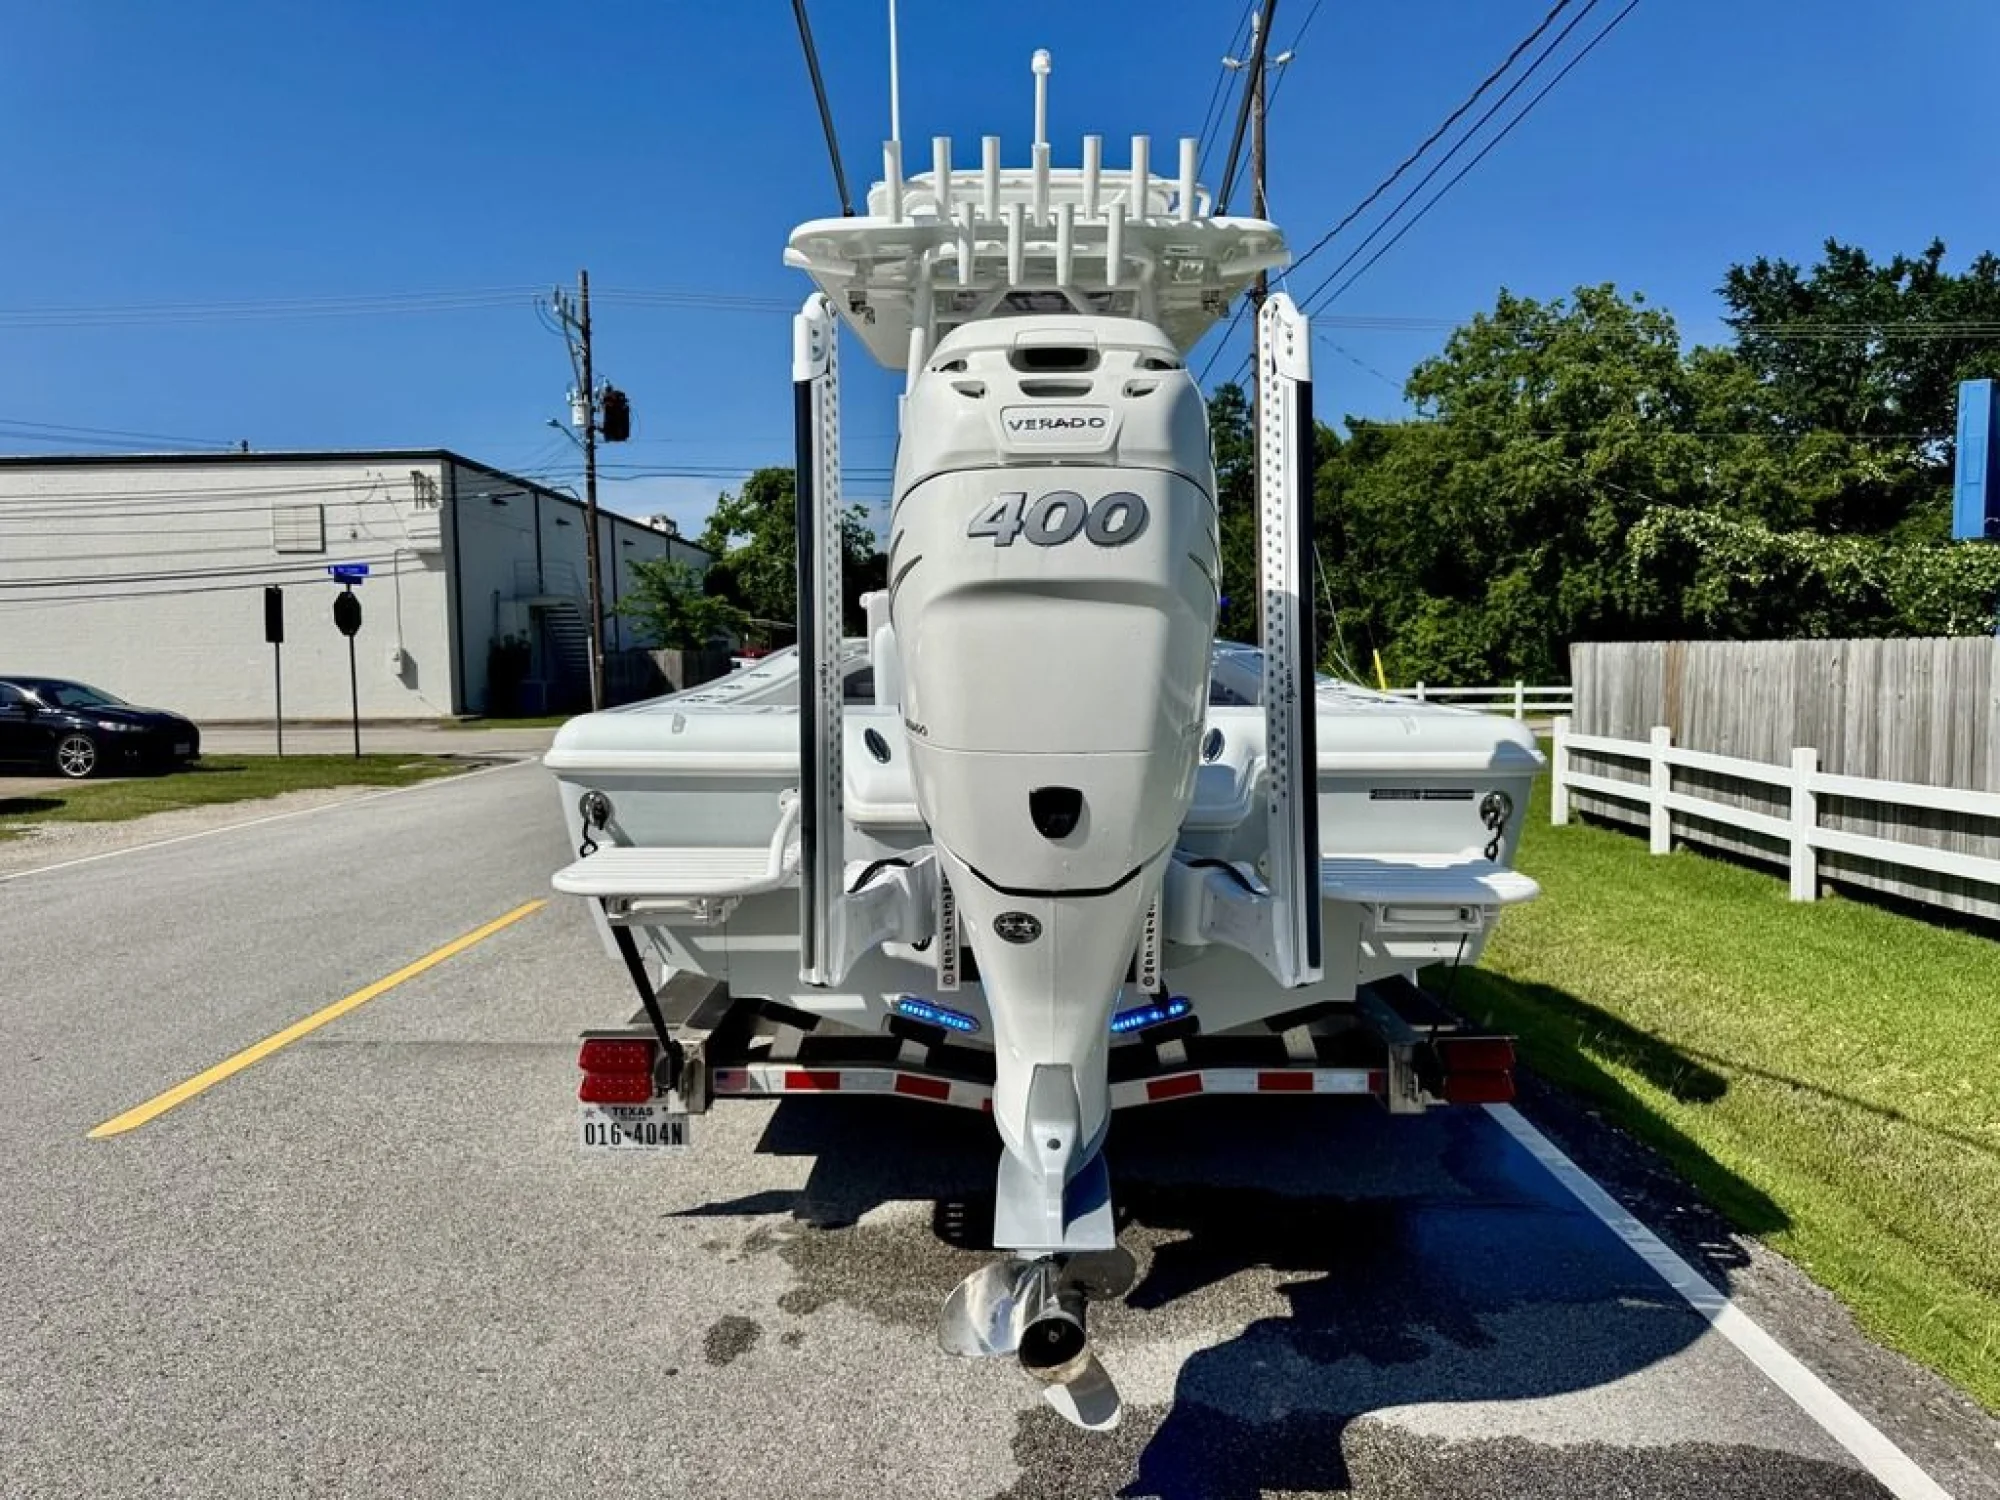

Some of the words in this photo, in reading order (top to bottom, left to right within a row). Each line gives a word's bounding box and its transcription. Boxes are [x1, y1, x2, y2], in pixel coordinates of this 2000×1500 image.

[1007, 417, 1106, 431] VERADO
[967, 491, 1150, 548] 400
[612, 1107, 653, 1116] TEXAS
